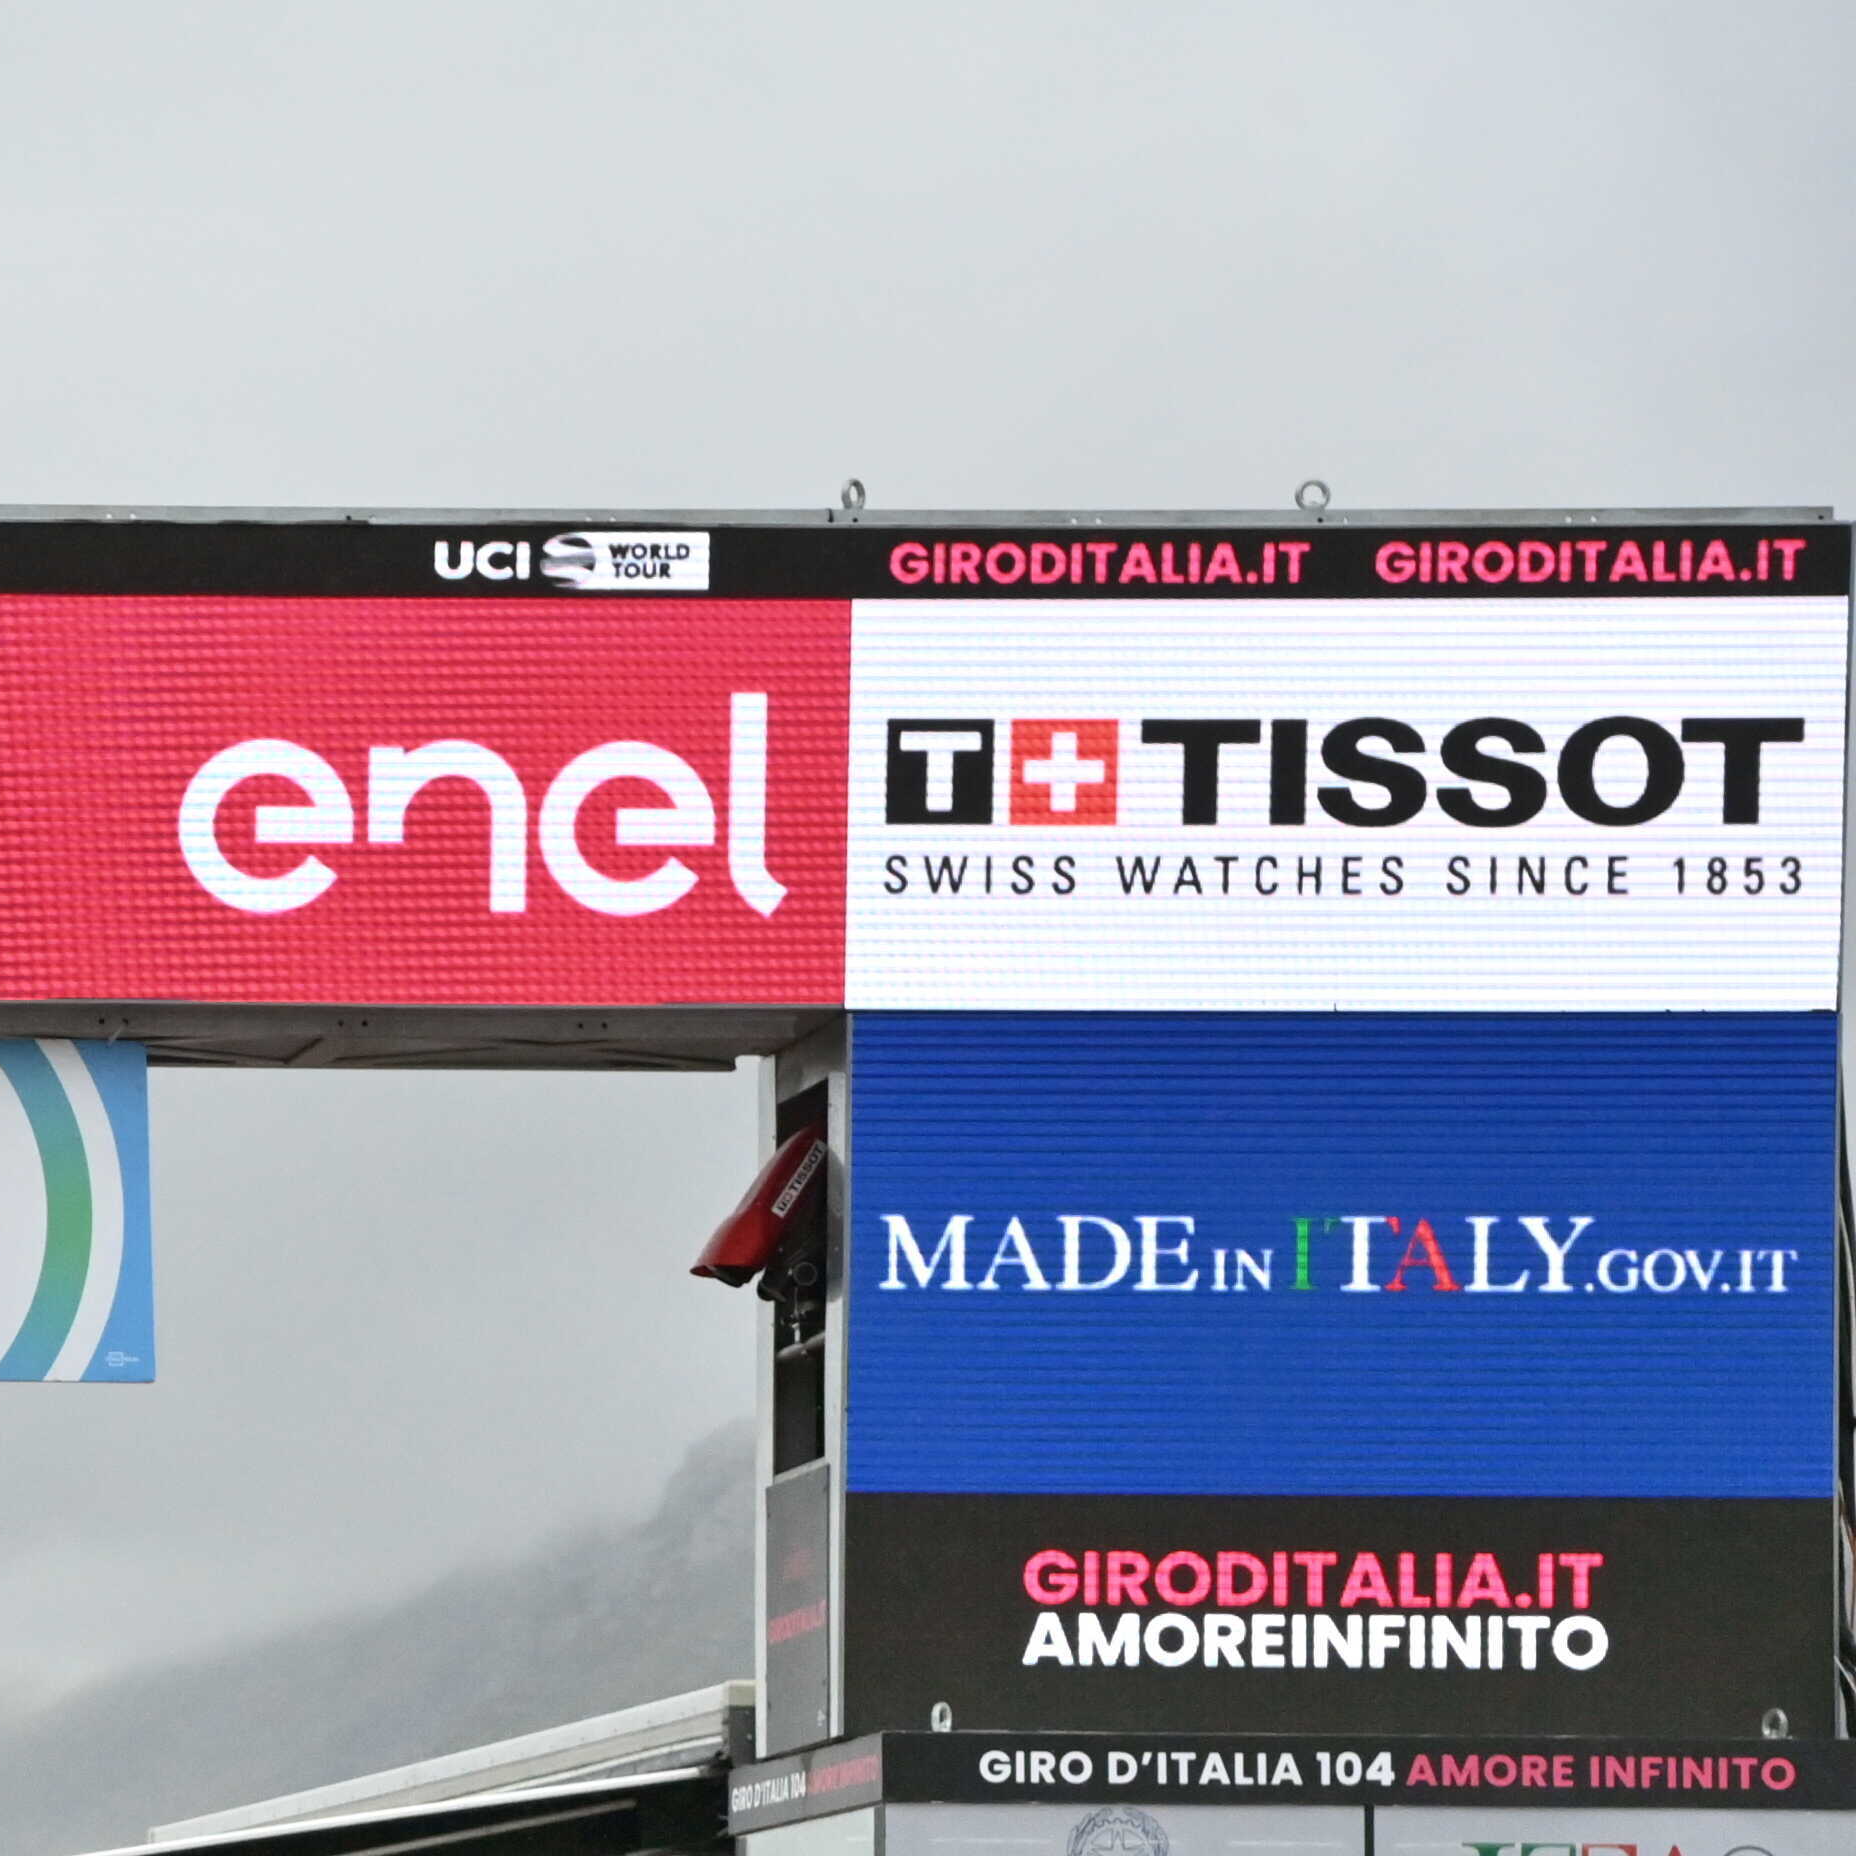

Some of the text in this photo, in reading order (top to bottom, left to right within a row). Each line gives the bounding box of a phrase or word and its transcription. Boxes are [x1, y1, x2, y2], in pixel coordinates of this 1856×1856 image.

[434, 539, 531, 581] UCI
[609, 543, 690, 563] WORLD
[612, 561, 674, 580] TOUR
[888, 542, 1310, 585] GIRODITALIA.IT
[1374, 539, 1806, 582] GIRODITALIA.IT
[1141, 716, 1805, 827] TISSOT
[177, 690, 788, 920] enel
[884, 855, 1806, 895] SWISS WATCHES SINCE 1853
[879, 1213, 1798, 1295] MADE IN ITALY.GOV.IT
[1022, 1549, 1604, 1610] GIRODITALIA.IT
[1021, 1612, 1610, 1673] AMOREINFINITO
[977, 1748, 1797, 1792] GIRO D'ITALIA 104 AMORE INFINITO
